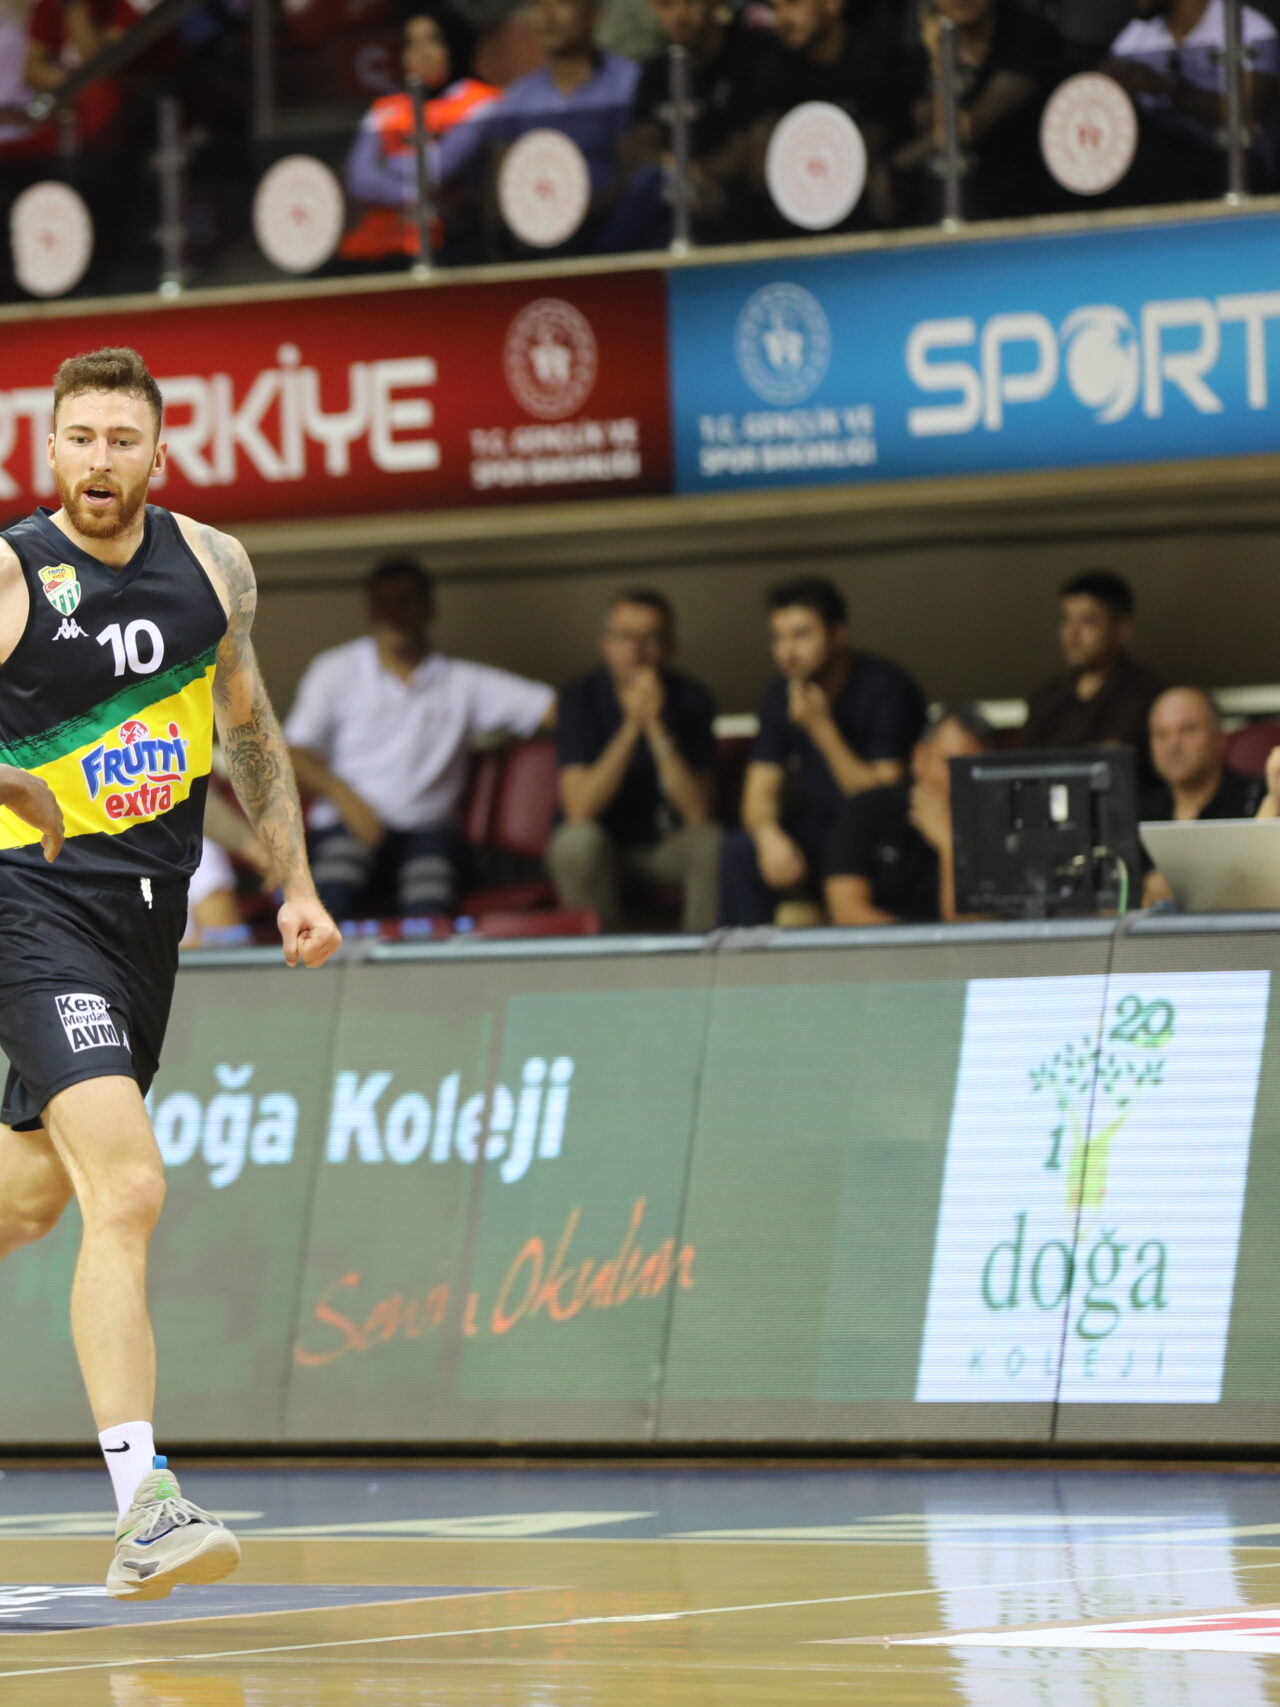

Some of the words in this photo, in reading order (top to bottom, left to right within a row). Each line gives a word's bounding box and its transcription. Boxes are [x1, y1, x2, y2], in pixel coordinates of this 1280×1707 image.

[906, 290, 1280, 437] SPORT
[95, 619, 164, 677] 10
[104, 781, 172, 820] extra
[72, 1024, 119, 1050] AVM
[145, 1062, 299, 1189] oğa
[326, 1056, 574, 1184] Koleji
[981, 1208, 1169, 1340] doğa
